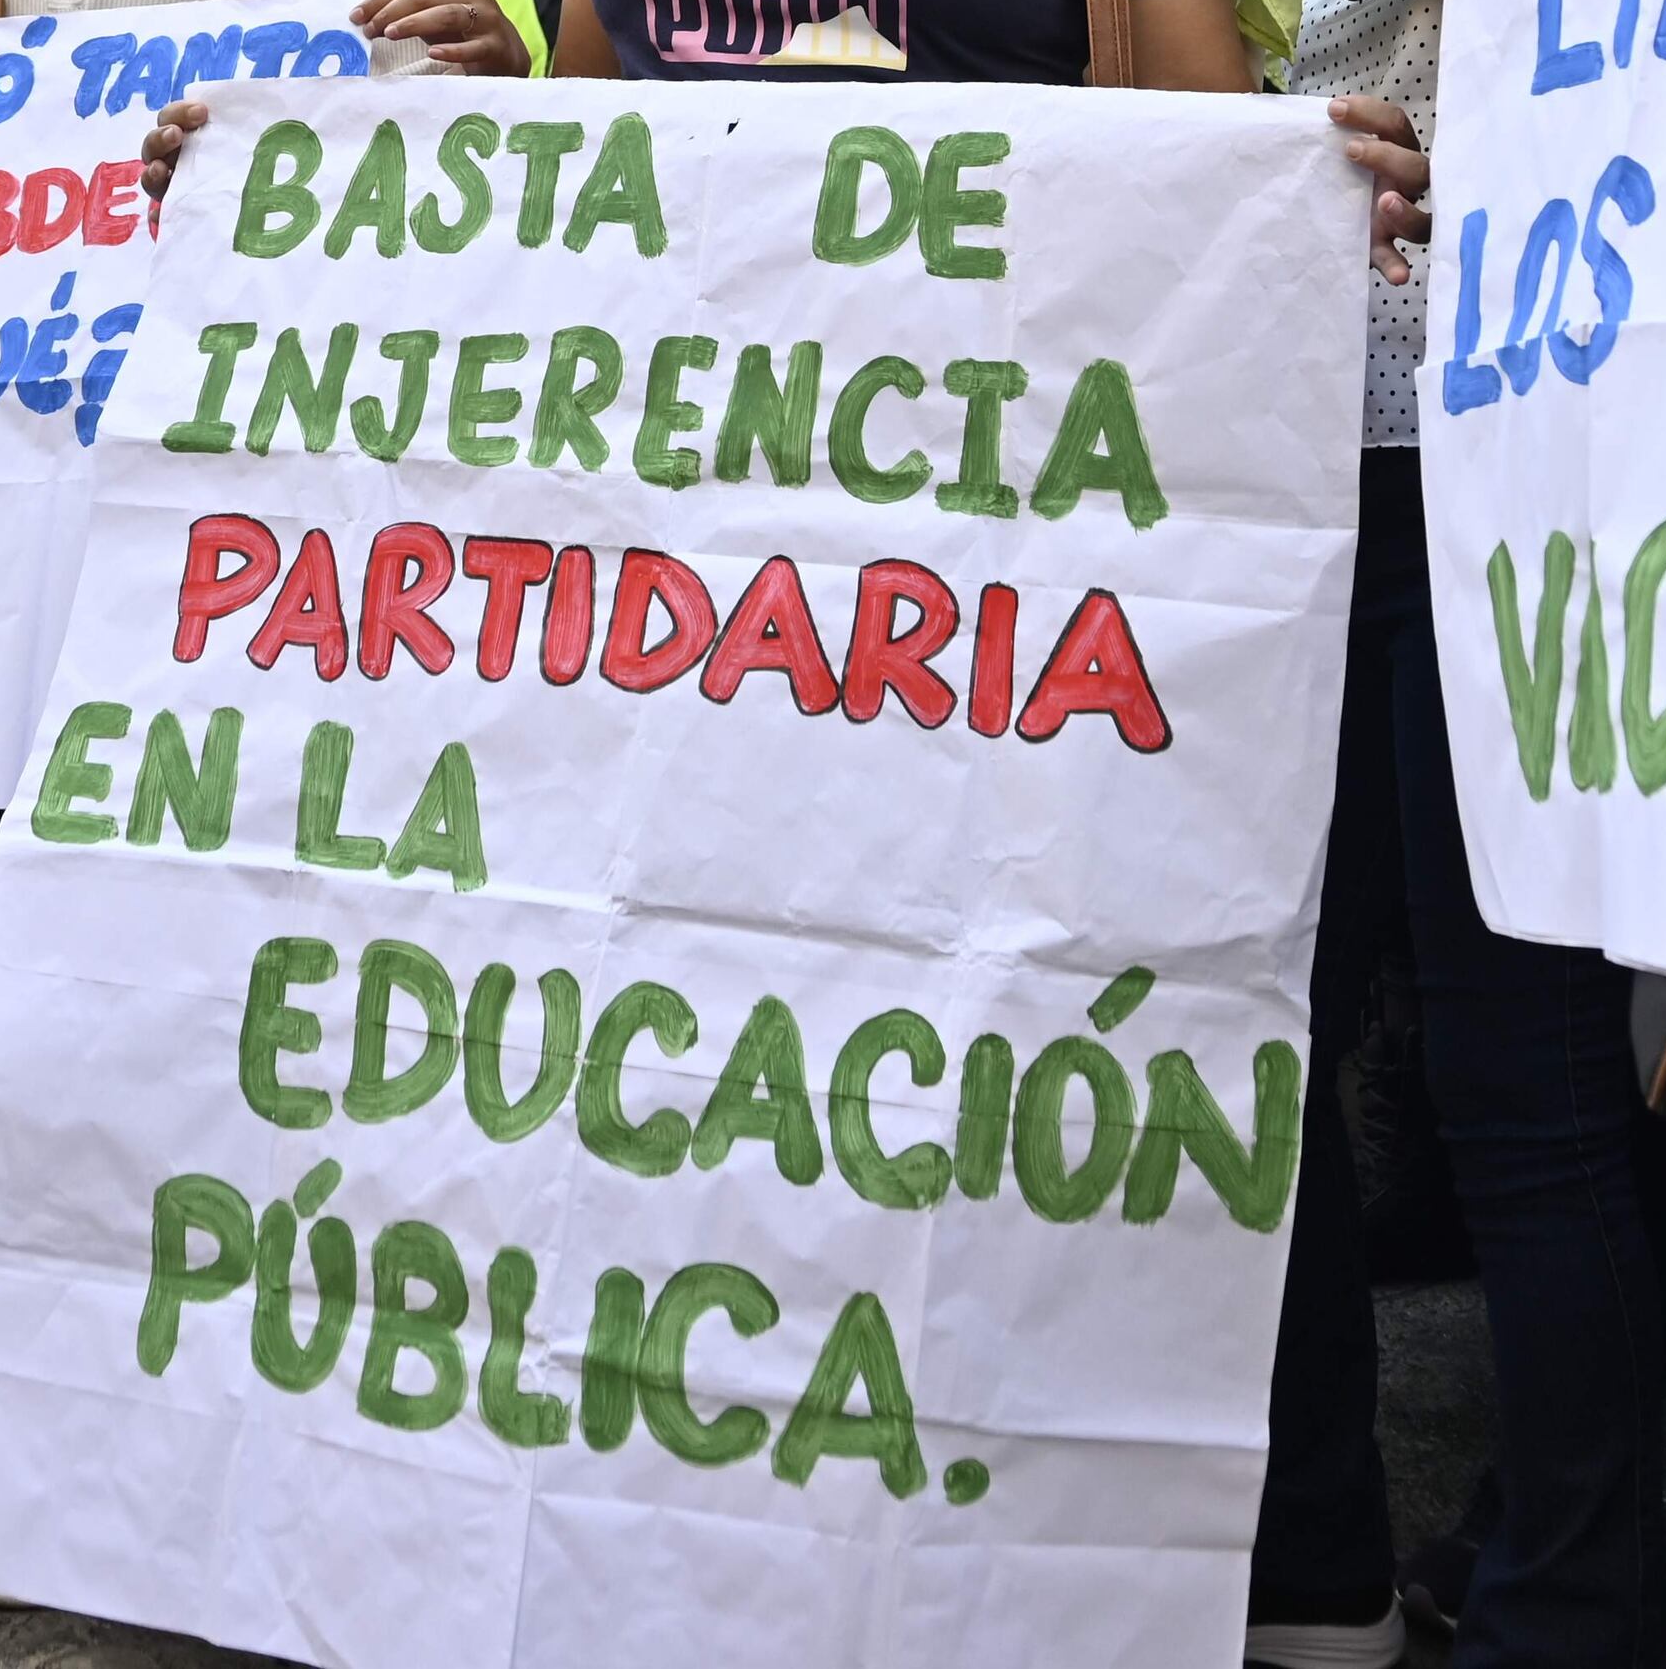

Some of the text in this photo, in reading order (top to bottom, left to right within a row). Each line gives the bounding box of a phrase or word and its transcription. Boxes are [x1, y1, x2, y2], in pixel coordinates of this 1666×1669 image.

[233, 112, 1012, 281] BASTA DE
[1440, 153, 1656, 417] LOS
[160, 322, 1169, 531] INJERENCIA
[172, 512, 1173, 754] PARTIDARIA
[30, 699, 486, 892] EN LA
[238, 935, 1303, 1234] EDUCACIÓN
[134, 1159, 991, 1506] PÚBLICA.
